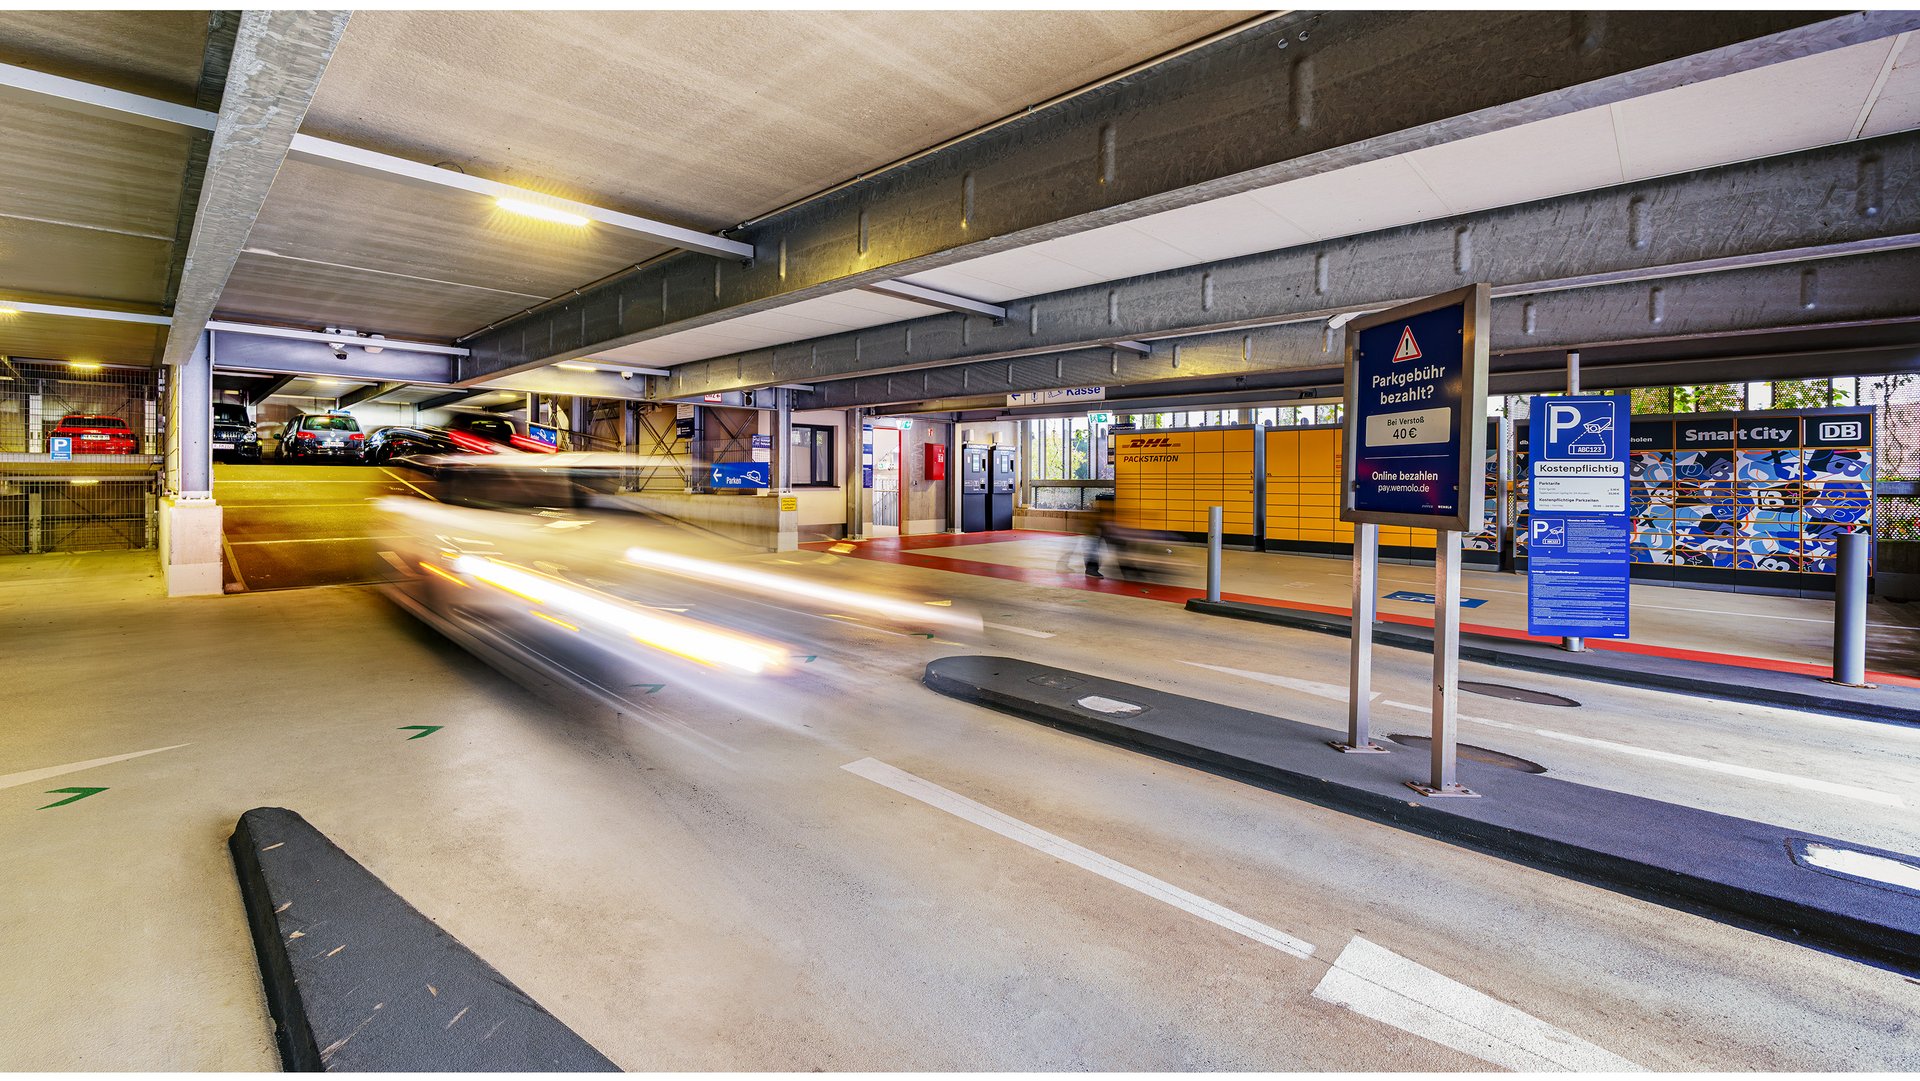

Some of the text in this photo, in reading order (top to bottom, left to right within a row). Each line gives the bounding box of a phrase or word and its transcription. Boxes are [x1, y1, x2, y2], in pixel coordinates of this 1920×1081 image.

[1372, 364, 1446, 388] Parkgebühr
[1380, 384, 1435, 405] bezahlt?
[1387, 416, 1425, 427] Bei Verstoß
[1549, 405, 1582, 444] P
[1685, 426, 1793, 443] Smart City
[1822, 424, 1858, 439] DB
[1129, 438, 1173, 448] DHL
[1123, 455, 1179, 463] PACKSTATION
[1539, 464, 1619, 474] Kostenpflichtig
[726, 476, 742, 485] Parken
[1371, 471, 1439, 481] Online bezahlen
[1377, 483, 1430, 493] pay.wemolo.de
